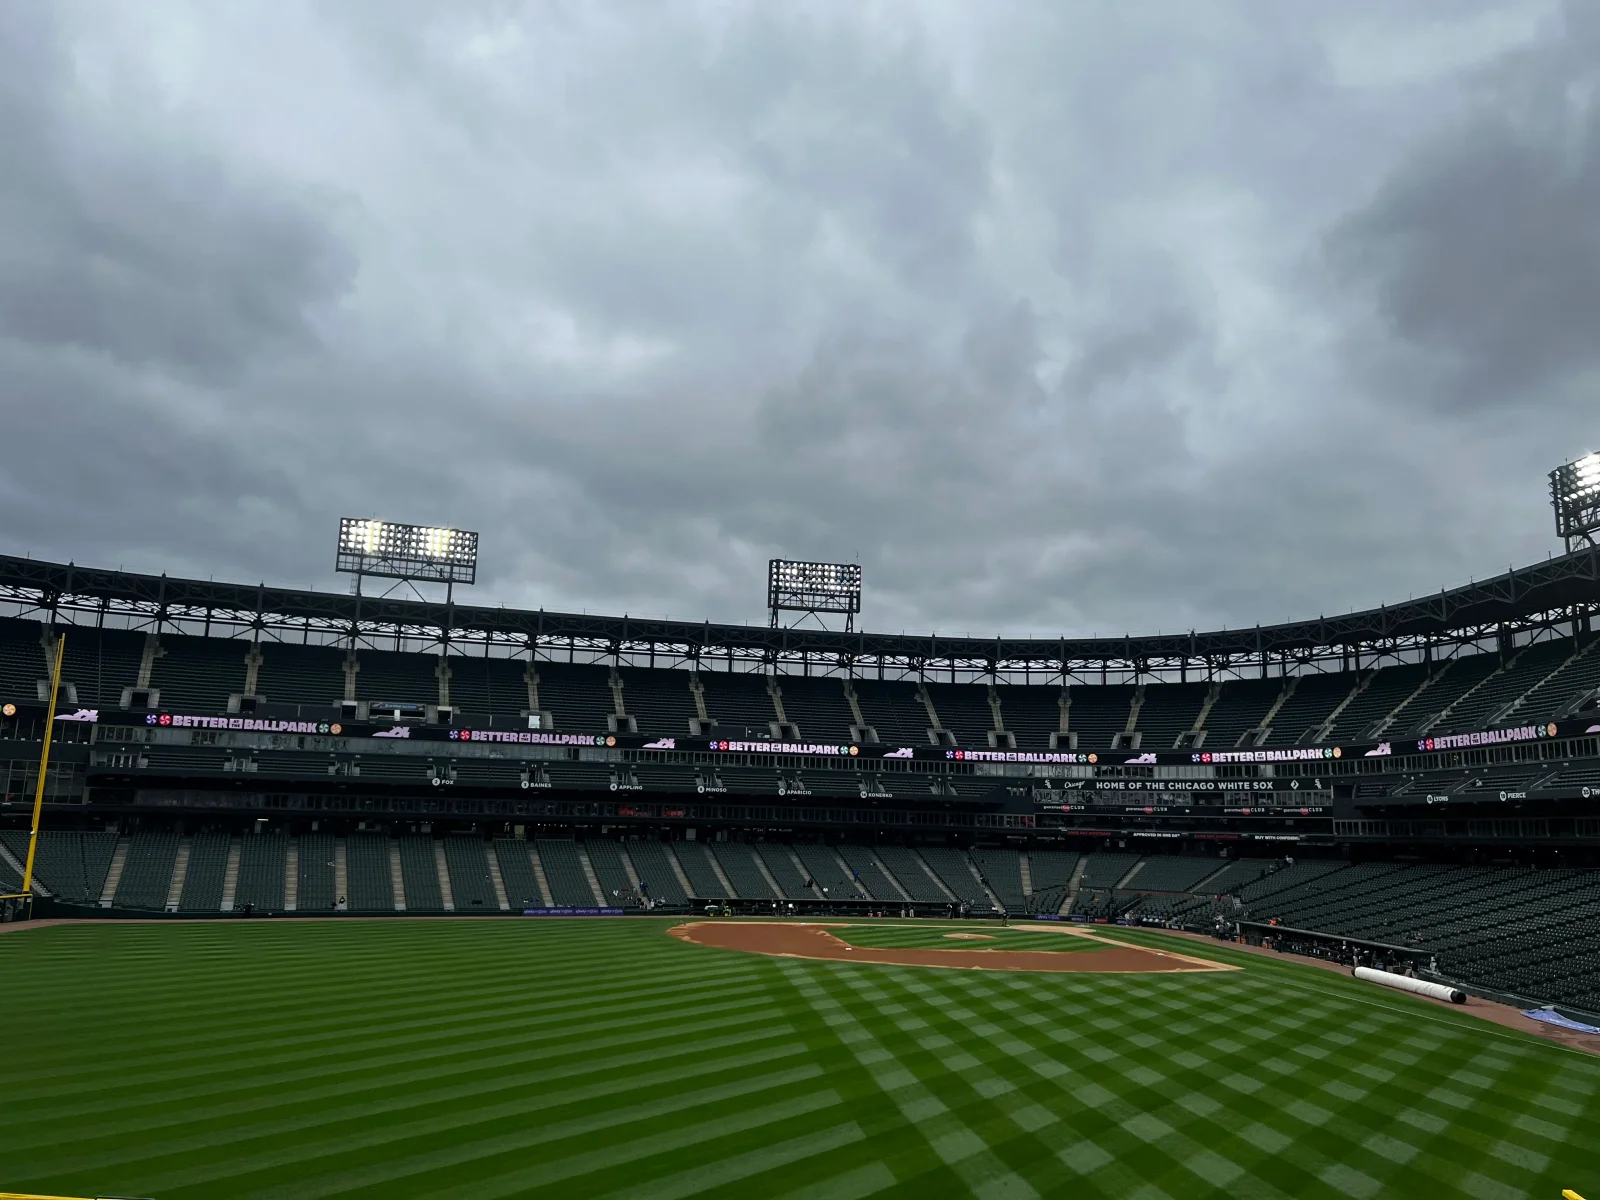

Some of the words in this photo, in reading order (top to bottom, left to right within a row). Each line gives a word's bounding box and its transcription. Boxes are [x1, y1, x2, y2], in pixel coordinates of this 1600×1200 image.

[172, 715, 228, 729] BETTER
[244, 719, 317, 733] BALLPARK
[471, 731, 520, 742] BETTER
[531, 734, 595, 745] BALLPARK
[1434, 734, 1471, 749] BETTER
[1481, 725, 1537, 743] BALLPARK
[728, 741, 770, 752] BETTER
[782, 744, 839, 755] BALLPARK
[964, 751, 1005, 761] BETTER
[1017, 752, 1077, 763] BALLPARK
[1212, 752, 1255, 762] BETTER
[1266, 749, 1324, 761] BALLPARK
[1096, 781, 1125, 790] HOME
[1128, 782, 1143, 790] OF
[1145, 782, 1165, 790] THE
[1168, 782, 1215, 790] CHICAGO
[1217, 782, 1250, 790] WHITE
[1253, 781, 1274, 790] SOX
[1507, 792, 1526, 800] PIERCE
